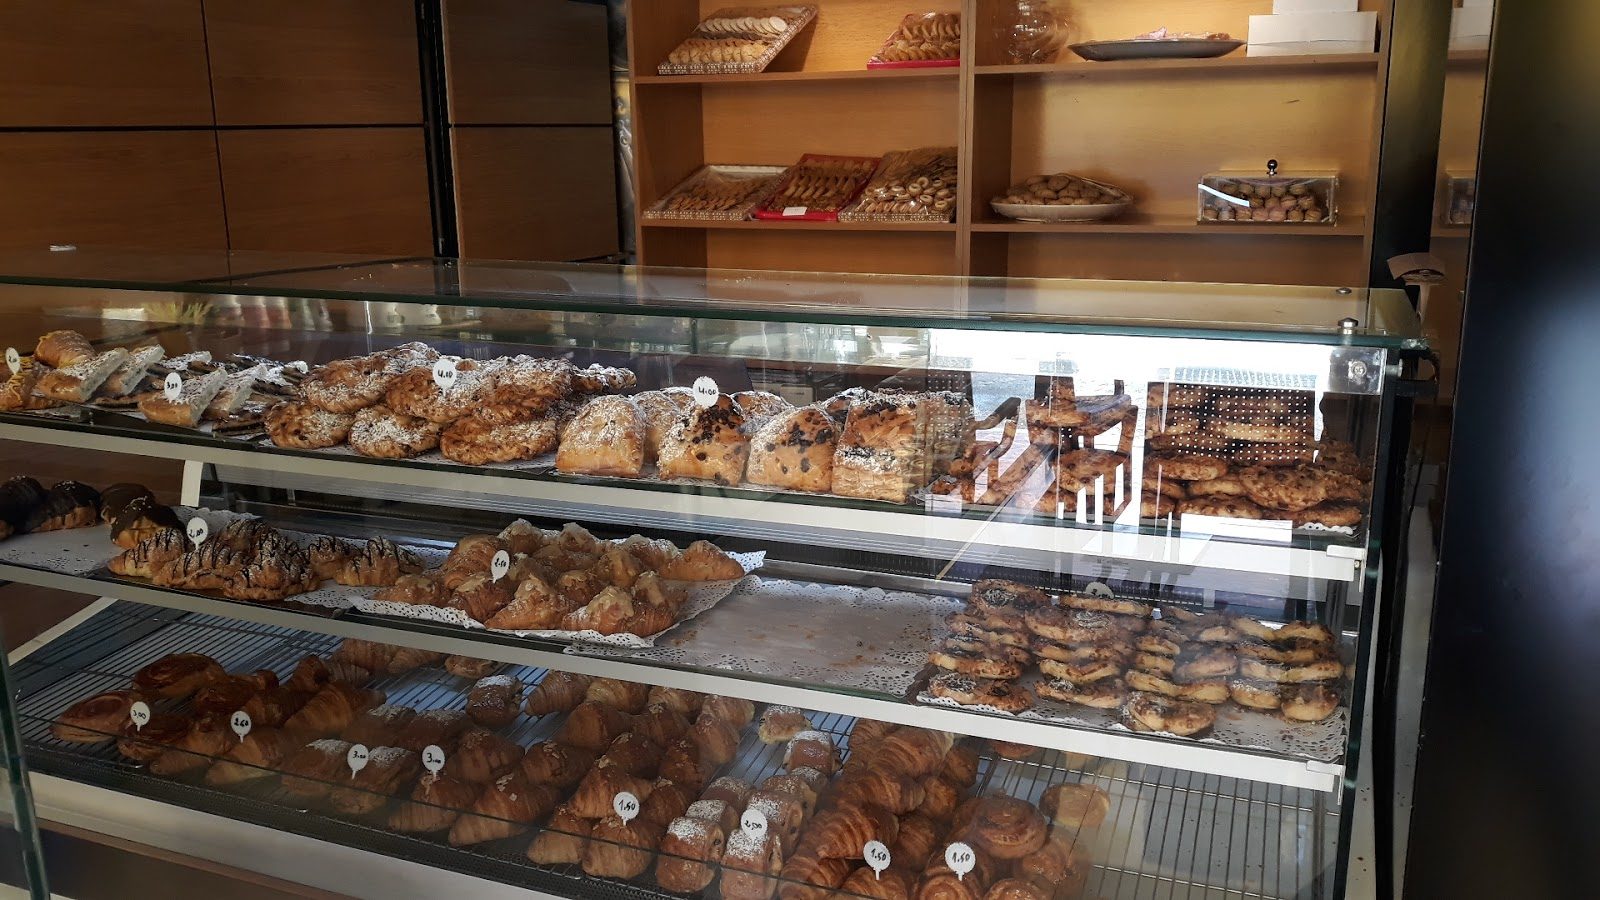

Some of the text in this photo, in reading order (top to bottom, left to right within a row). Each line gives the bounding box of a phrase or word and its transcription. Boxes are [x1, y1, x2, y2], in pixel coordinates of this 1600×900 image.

[698, 387, 716, 396] 4.00
[618, 800, 636, 811] 1.50
[870, 848, 886, 861] 1.50
[952, 852, 970, 864] 1.50
